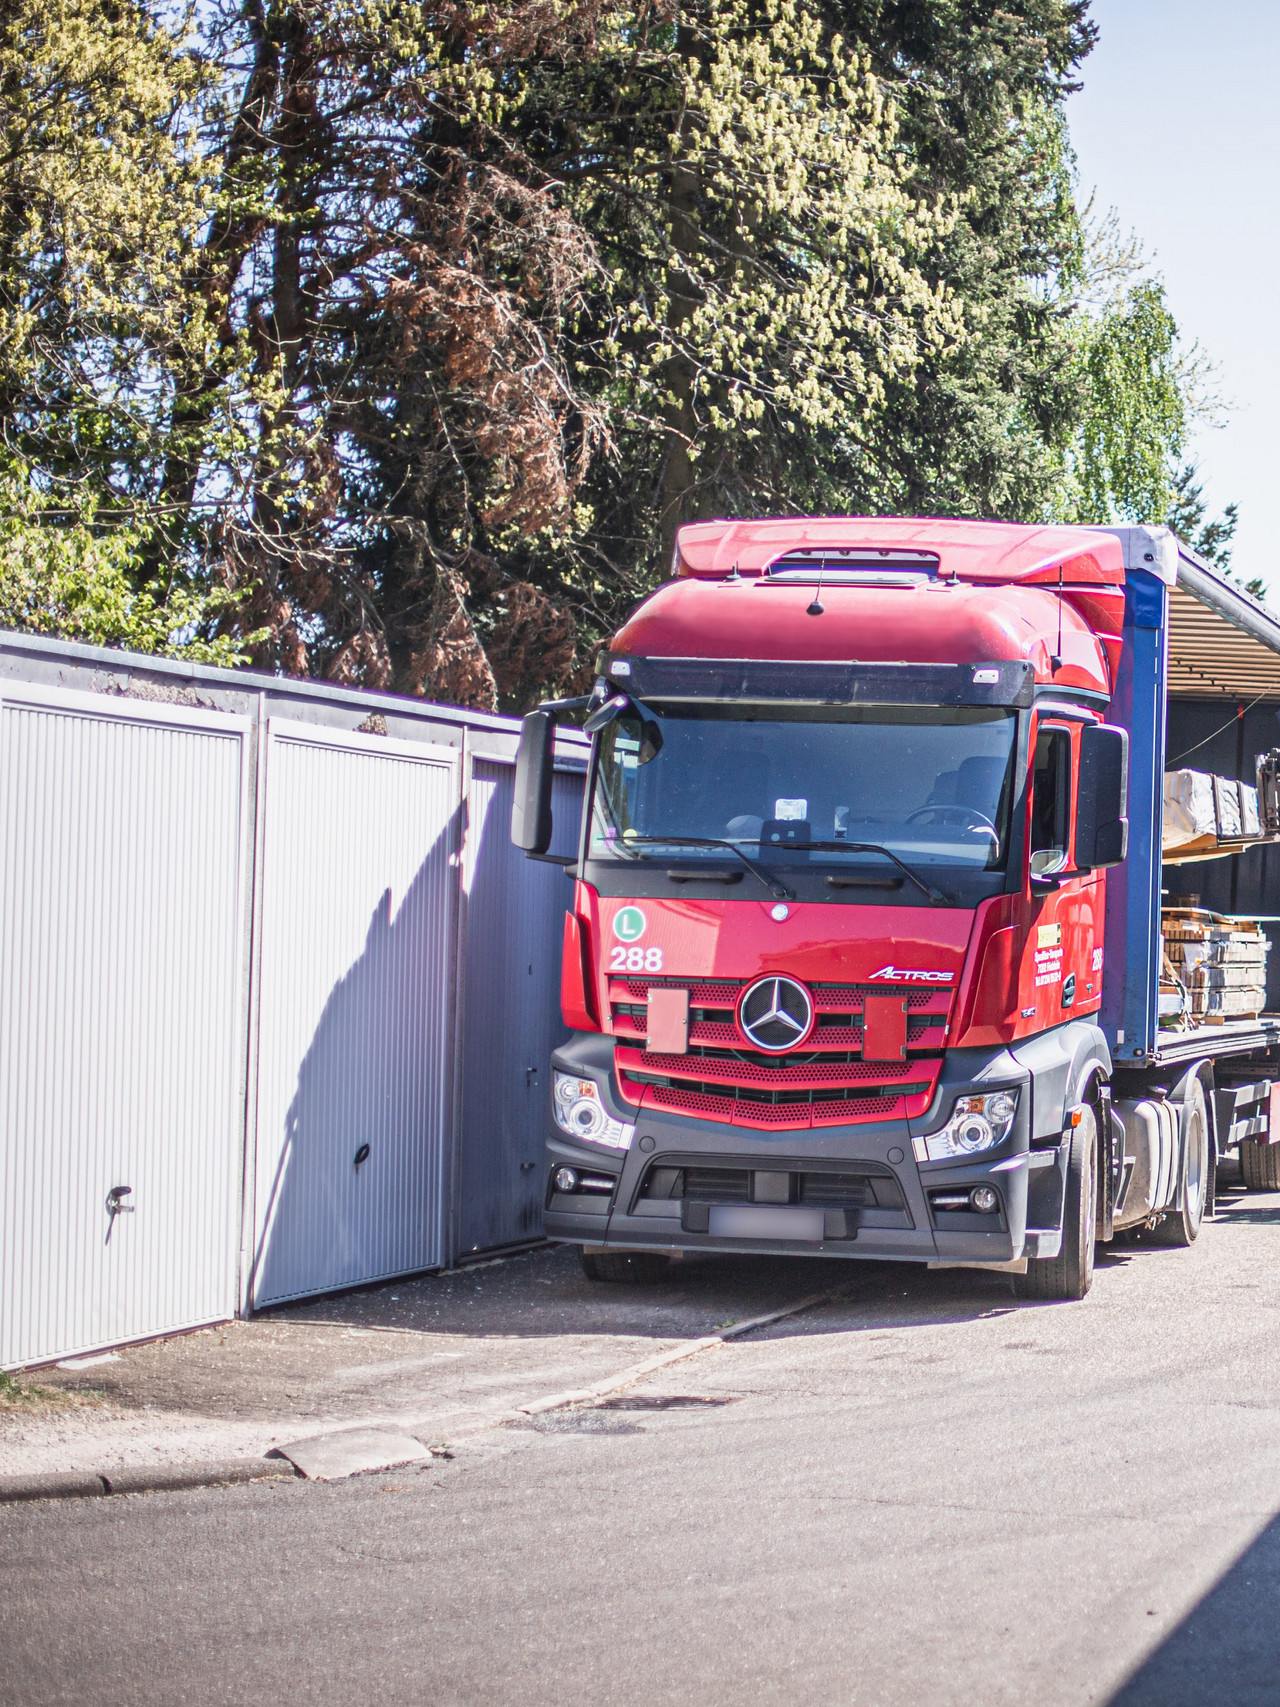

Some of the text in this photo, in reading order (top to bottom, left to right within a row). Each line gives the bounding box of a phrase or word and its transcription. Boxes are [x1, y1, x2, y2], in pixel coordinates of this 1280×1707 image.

[622, 913, 636, 935] L
[609, 946, 663, 972] 288
[1092, 947, 1103, 971] 288
[868, 966, 955, 982] ACTROS
